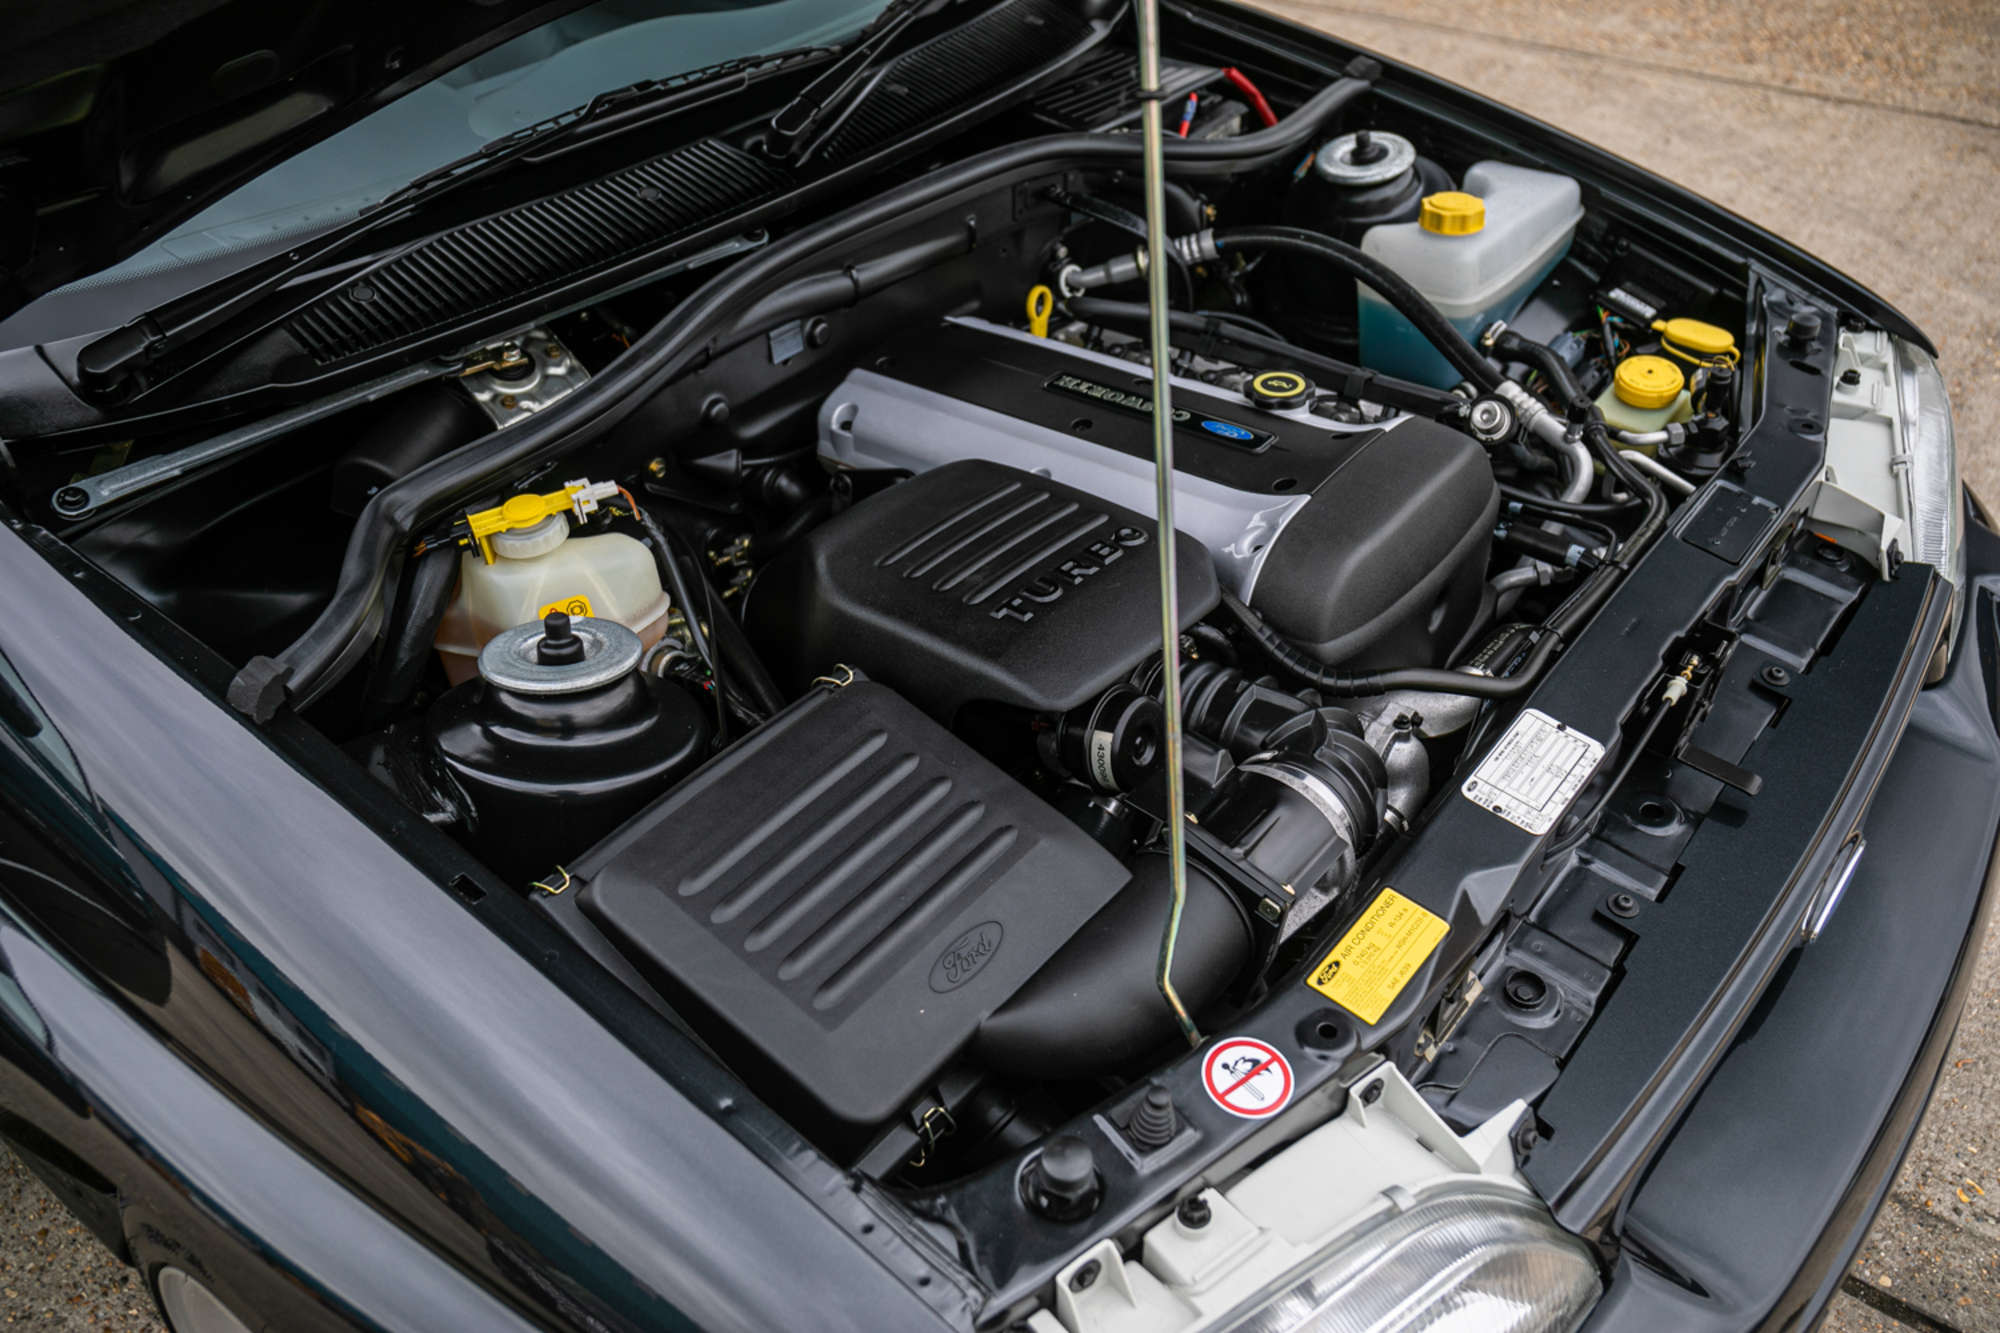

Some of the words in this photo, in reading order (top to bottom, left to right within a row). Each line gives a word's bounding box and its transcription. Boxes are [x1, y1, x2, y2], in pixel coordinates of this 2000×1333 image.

[1053, 375, 1192, 421] CSWORTH
[989, 526, 1149, 623] TURBO
[1340, 944, 1354, 960] AIR
[1350, 893, 1397, 946] CONDITIONER
[941, 931, 993, 984] Ford
